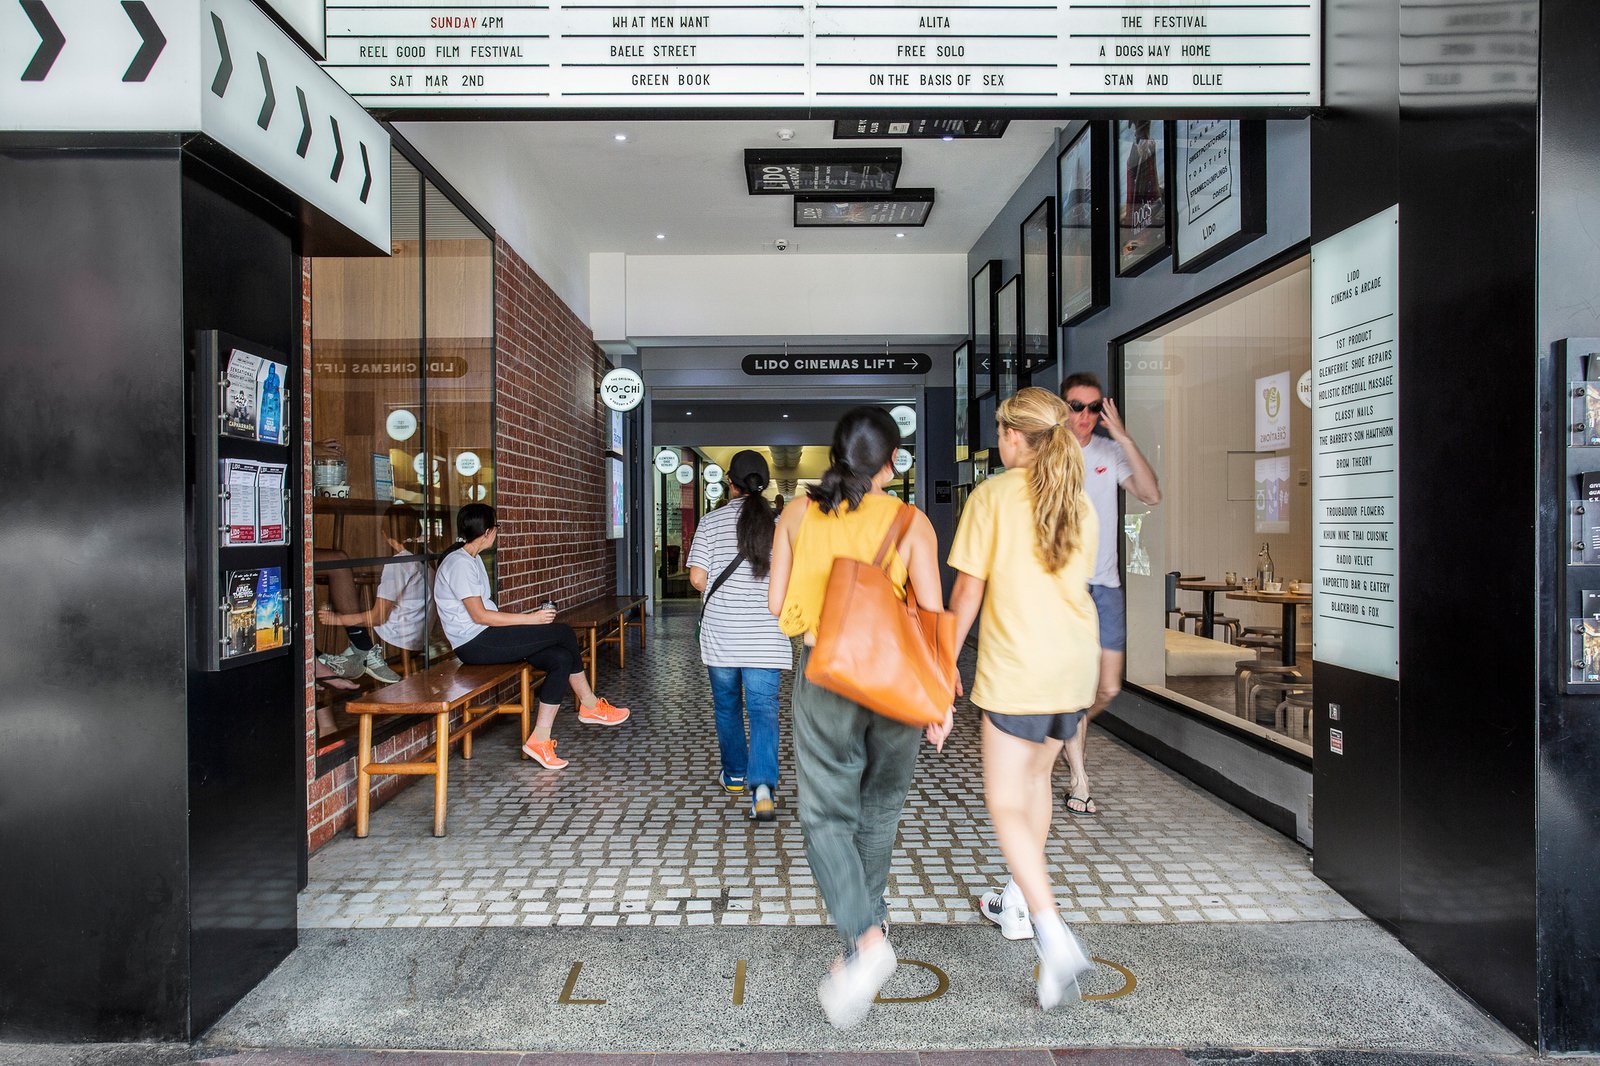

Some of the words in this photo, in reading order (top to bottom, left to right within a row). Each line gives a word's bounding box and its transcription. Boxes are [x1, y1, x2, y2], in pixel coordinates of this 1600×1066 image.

[431, 17, 476, 28] SUNDAY
[482, 17, 503, 28] 4PM
[613, 16, 645, 27] WHAT
[652, 17, 673, 27] MEN
[681, 16, 709, 27] WANT
[920, 17, 950, 28] ALITA
[1122, 16, 1142, 27] THE
[1155, 16, 1207, 27] FESTIVAL
[360, 46, 387, 57] REEL
[397, 46, 425, 57] GOOD
[437, 46, 459, 57] FILM
[472, 46, 522, 57] FESTIVAL
[611, 46, 644, 57] BAELE
[654, 45, 696, 56] STREET
[898, 46, 925, 56] FREE
[937, 46, 964, 57] SOLO
[1100, 45, 1105, 56] A
[1116, 45, 1143, 56] DOGS
[1149, 45, 1170, 56] WAY
[1182, 45, 1210, 56] HOME
[391, 75, 412, 86] SAT
[426, 75, 447, 86] MAR
[462, 75, 483, 86] 2ND
[632, 74, 668, 85] GREEN
[679, 74, 709, 85] BOOK
[870, 74, 883, 85] ON
[888, 75, 909, 85] THE
[921, 75, 951, 85] BASIS
[958, 75, 971, 85] OF
[983, 75, 1004, 86] SEX
[1105, 74, 1133, 85] STAN
[1147, 74, 1168, 85] AND
[1193, 74, 1222, 85] OLLIE
[1188, 147, 1227, 181] TOASTIES
[762, 166, 790, 190] LIDO
[1202, 222, 1216, 240] LIDO
[1347, 270, 1359, 284] LIDO
[1330, 288, 1352, 304] CINEMAS
[1354, 287, 1358, 296] &
[1361, 276, 1381, 293] ARCADE
[1336, 338, 1345, 350] 1ST
[1348, 330, 1372, 346] PRODUCT
[755, 359, 789, 370] LIDO
[794, 359, 859, 369] CINEMAS
[864, 359, 895, 369] LIFT
[1319, 361, 1348, 378] GLENFERRIE
[1351, 356, 1364, 370] SHOE
[1368, 350, 1392, 366] REPAIRS
[1319, 386, 1340, 400] HOLISTIC
[1341, 380, 1366, 396] REMEDIAL
[1368, 374, 1392, 390] MASSAGE
[1335, 409, 1354, 421] CLASSY
[1357, 405, 1373, 417] NAILS
[1319, 435, 1328, 446] THE
[1329, 430, 1352, 444] BARBER'S
[1354, 429, 1364, 440] SON
[1365, 426, 1393, 440] HAWTHORN
[1336, 457, 1349, 469] BROW
[1352, 456, 1372, 467] THEORY
[1326, 507, 1357, 517] TROUBADOUR
[1361, 506, 1384, 516] FLOWERS
[1323, 530, 1336, 541] KHUN
[1339, 530, 1350, 541] NINE
[1352, 531, 1364, 541] THAI
[1367, 531, 1388, 542] CUISINE
[1336, 555, 1351, 565] RADIO
[1354, 555, 1373, 567] VELVET
[1322, 576, 1349, 589] VAPORETTO
[1351, 580, 1361, 591] BAR
[1363, 581, 1368, 591] &
[1369, 581, 1390, 593] EATERY
[1331, 602, 1359, 616] BLACKBIRD
[1361, 605, 1366, 615] &
[1368, 606, 1379, 617] FOX
